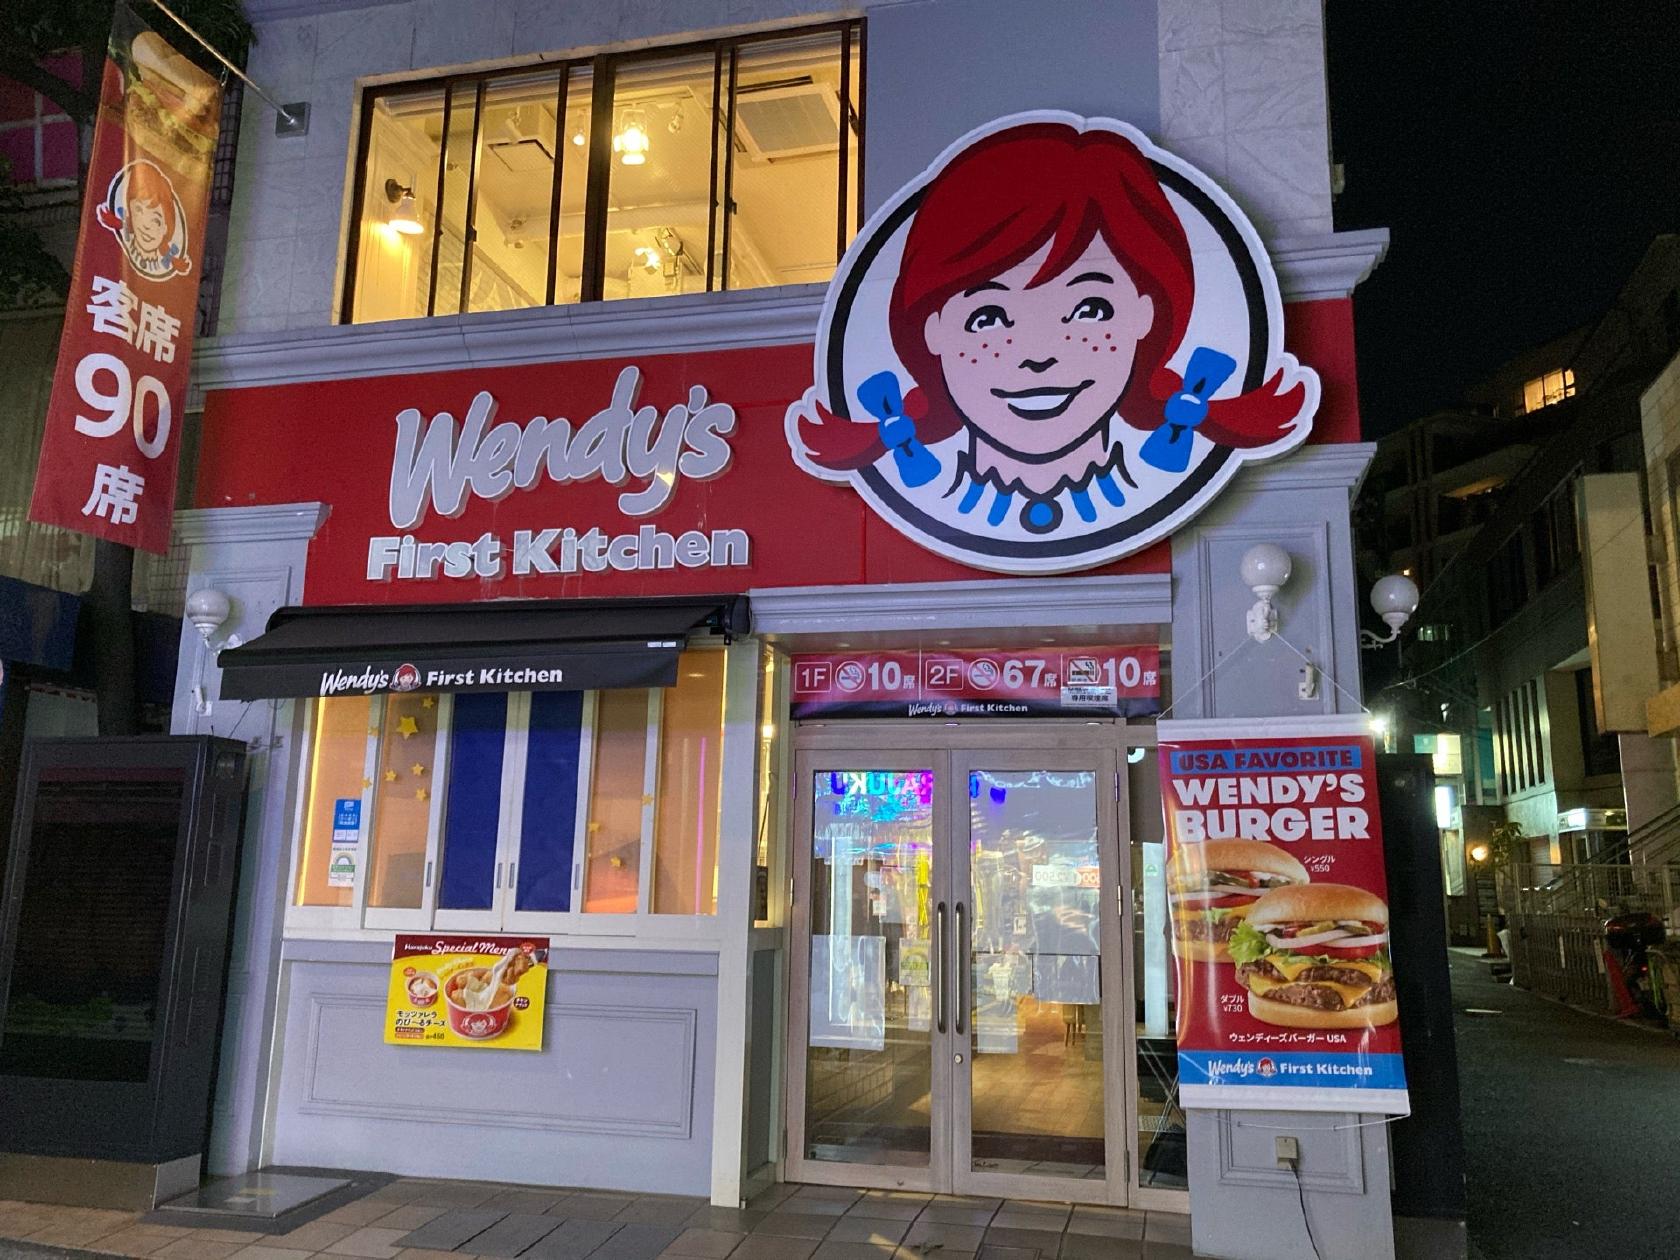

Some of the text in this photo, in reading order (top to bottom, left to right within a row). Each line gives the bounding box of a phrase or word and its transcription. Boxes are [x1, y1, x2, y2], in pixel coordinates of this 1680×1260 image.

[86, 274, 181, 364] 客席
[74, 352, 171, 460] 90
[389, 365, 737, 529] Wendy's
[81, 463, 145, 525] 席
[367, 524, 751, 581] First Kitchen
[320, 665, 563, 696] Wendy's First Kitchen
[801, 666, 827, 688] 1F
[929, 665, 960, 687] 2F
[908, 703, 1028, 717] Wendy's First Kitchen
[1178, 749, 1353, 772] USA FAVORITE
[1172, 773, 1366, 806] WENDY'S
[1175, 806, 1370, 843] BURGER
[1303, 855, 1335, 864] シングル
[431, 940, 478, 955] Special
[479, 942, 511, 955] Men
[1220, 993, 1244, 1004] ダブル
[1229, 1032, 1347, 1044] ウェンディーズバーガー USA
[1207, 1057, 1373, 1077] Wendy's First Kitchen
